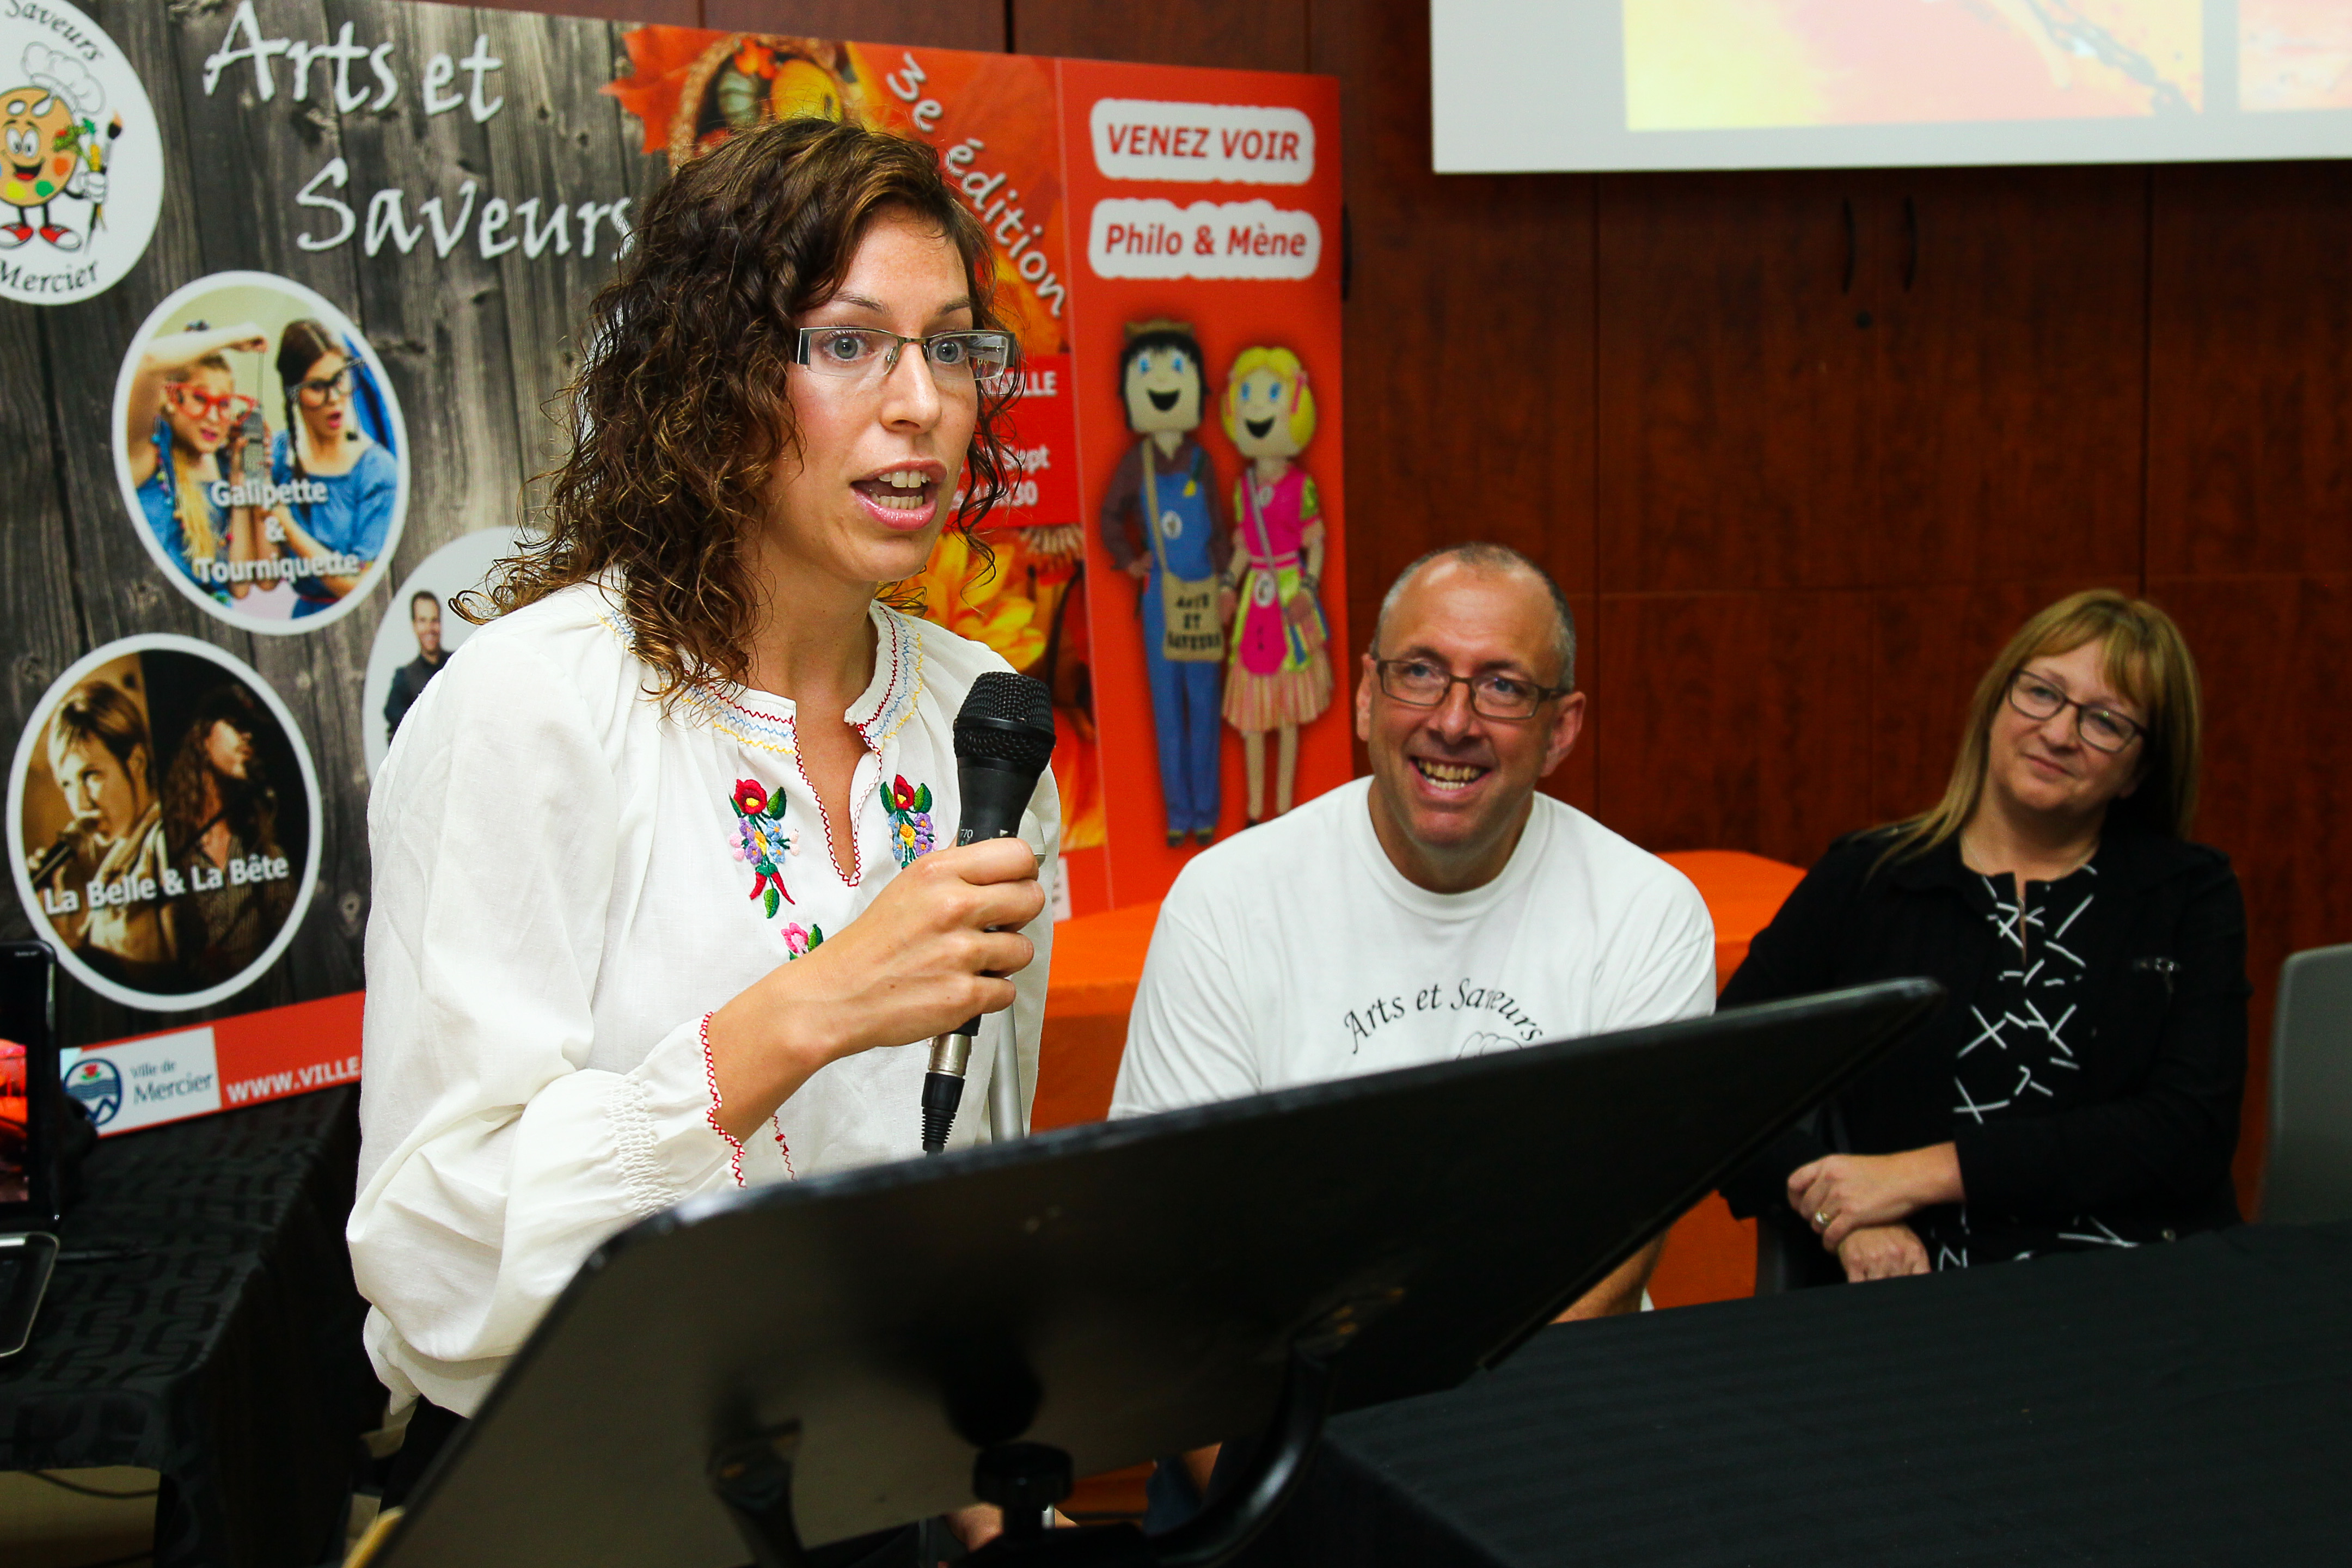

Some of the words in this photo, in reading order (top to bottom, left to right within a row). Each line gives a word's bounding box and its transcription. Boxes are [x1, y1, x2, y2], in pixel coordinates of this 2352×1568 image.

[5, 0, 104, 60] Saveurs
[203, 0, 400, 113] Arts
[423, 34, 504, 124] et
[1107, 123, 1210, 158] VENEZ
[1222, 128, 1300, 162] VOIR
[886, 52, 944, 133] 3e
[945, 138, 1065, 318] édition
[296, 157, 636, 262] Saveurs
[1105, 222, 1183, 255] Philo
[1194, 224, 1215, 256] &
[1226, 222, 1308, 257] Mène
[0, 259, 98, 292] Mercier
[211, 478, 329, 510] Galipette
[264, 516, 286, 543] &
[197, 550, 360, 584] Tourniquette
[44, 887, 80, 916] La
[86, 872, 157, 909] Belle
[163, 868, 186, 897] &
[191, 865, 224, 892] La
[229, 853, 290, 886] Bête
[1344, 997, 1405, 1054] Arts
[1417, 984, 1442, 1010] et
[130, 1063, 157, 1079] Ville
[161, 1059, 176, 1073] de
[133, 1072, 212, 1105] Mercier
